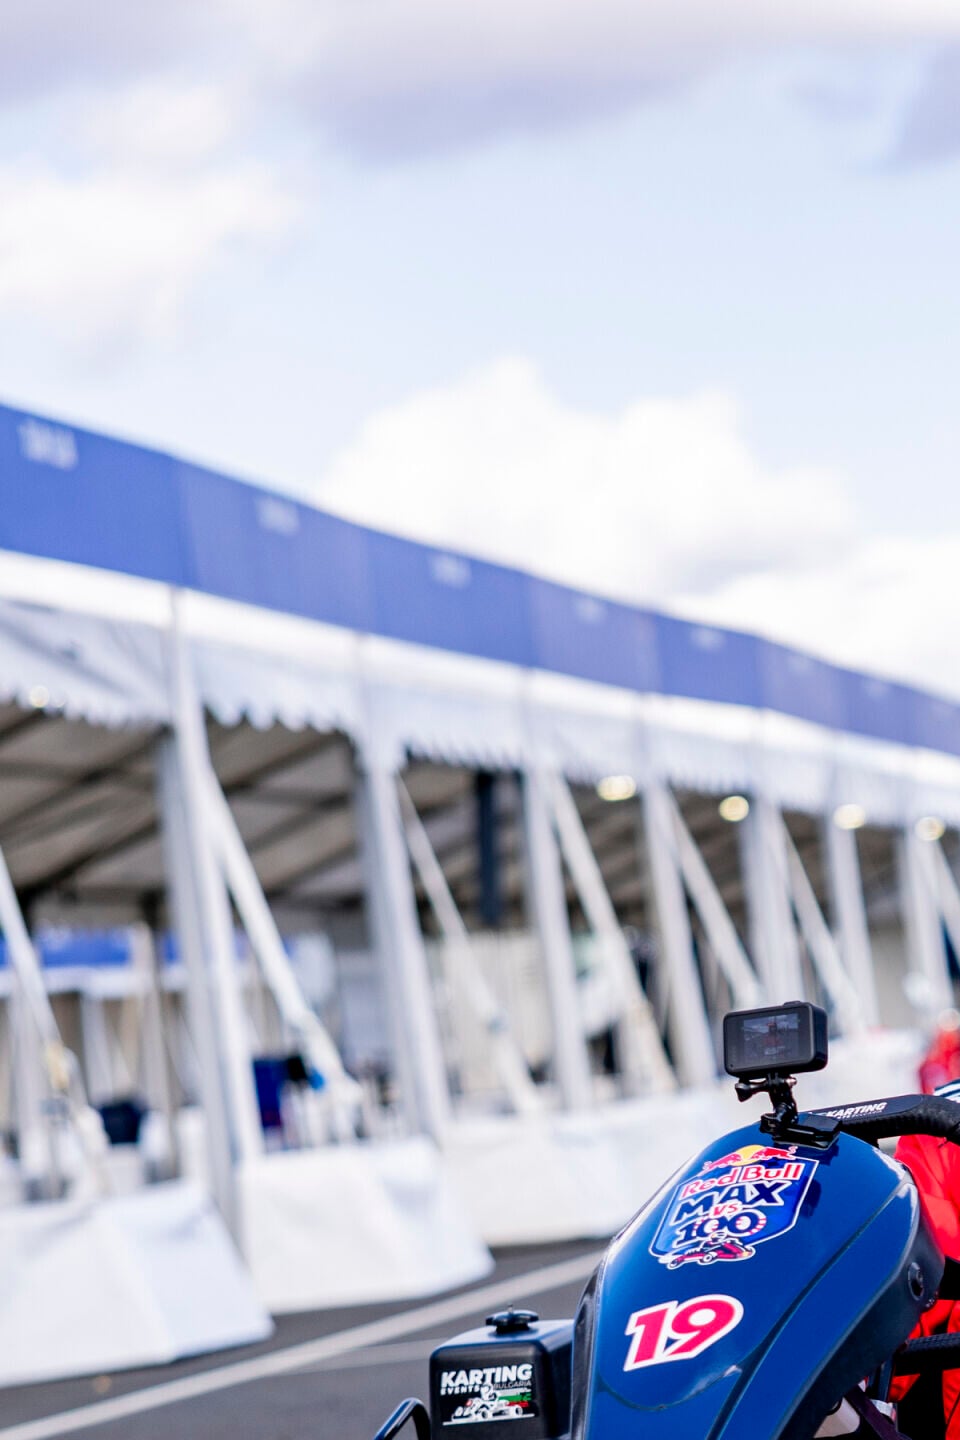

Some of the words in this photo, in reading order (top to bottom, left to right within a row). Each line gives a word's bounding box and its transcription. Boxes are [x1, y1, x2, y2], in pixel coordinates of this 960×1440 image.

[826, 1101, 888, 1118] KARTING
[679, 1167, 739, 1200] Red
[739, 1163, 806, 1183] Bull
[669, 1179, 793, 1226] MAX
[713, 1202, 740, 1216] VS
[672, 1209, 768, 1249] 100
[623, 1294, 744, 1372] 19
[440, 1363, 533, 1389] KARTING
[440, 1385, 481, 1396] EVENTS
